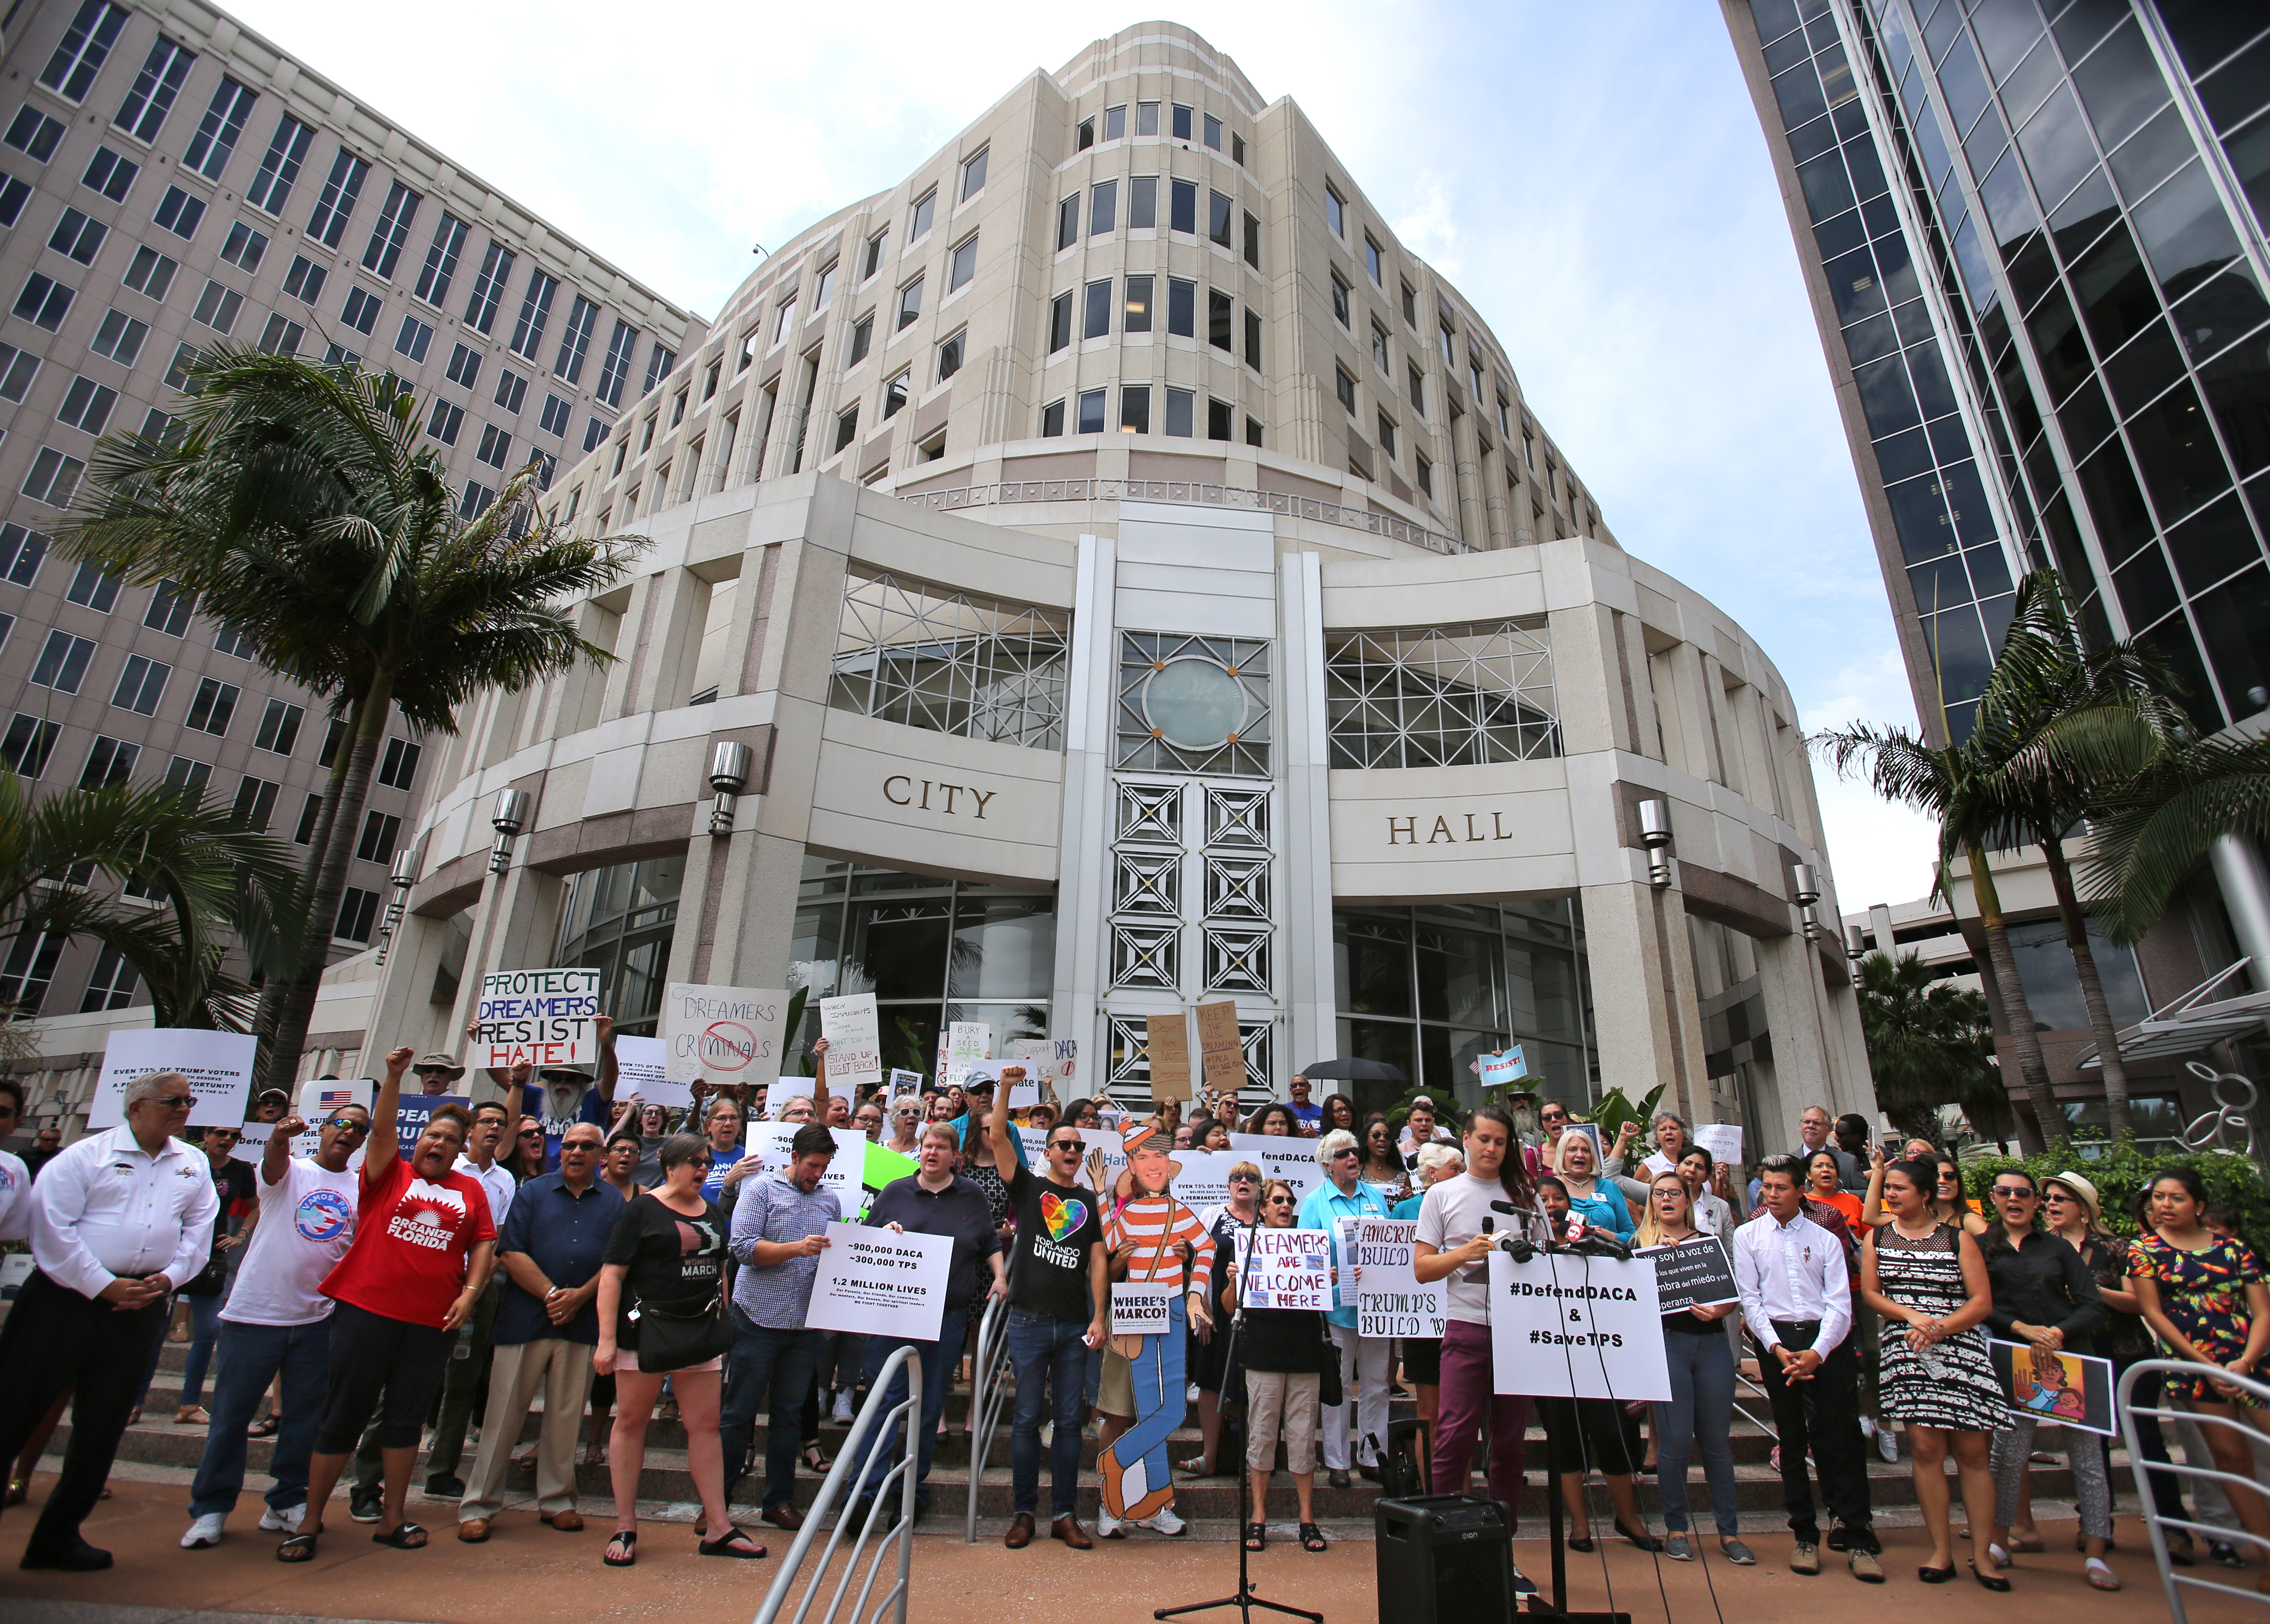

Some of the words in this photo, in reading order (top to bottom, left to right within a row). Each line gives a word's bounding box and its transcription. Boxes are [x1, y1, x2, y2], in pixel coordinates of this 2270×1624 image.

[883, 775, 998, 819] CITY
[1386, 812, 1512, 845] HALL
[482, 971, 599, 997] PROTECT
[479, 996, 598, 1020] DREAMERS
[685, 997, 776, 1021] DREAMERS
[830, 1008, 871, 1018] IMMIGRANTS
[1200, 1005, 1230, 1021] KEEP
[478, 1018, 589, 1045] RESIST
[958, 1026, 980, 1034] BURY
[1151, 1020, 1183, 1035] Deport
[676, 1034, 771, 1058] CRIMINALS
[829, 1038, 850, 1047] WHAT
[1015, 1040, 1051, 1057] Support
[1055, 1040, 1077, 1060] DACA
[1162, 1037, 1176, 1048] Hate
[1202, 1039, 1238, 1051] DREAMING
[828, 1053, 856, 1064] STAND
[852, 1056, 878, 1071] BACK!
[1161, 1051, 1181, 1061] NOT
[1206, 1055, 1229, 1064] #DACA
[1485, 1056, 1521, 1071] RESIST!
[1152, 1066, 1188, 1080] Dreamers
[1015, 1078, 1034, 1087] ate
[1103, 1153, 1127, 1165] Hat
[1262, 1152, 1315, 1163] fendDACA
[391, 1216, 455, 1241] ORGANIZE
[1360, 1224, 1417, 1244] AMERIC
[387, 1223, 448, 1251] FLORIDA
[1237, 1233, 1329, 1256] DREAMERS
[848, 1243, 892, 1254] ~900,000
[896, 1249, 923, 1258] DACA
[1036, 1234, 1080, 1257] #ORLANDO
[1659, 1253, 1675, 1262] soy
[1676, 1249, 1685, 1259] la
[1686, 1247, 1702, 1256] voz
[1703, 1243, 1714, 1253] de
[850, 1256, 894, 1267] ~300,000
[898, 1261, 917, 1270] TPS
[1033, 1243, 1078, 1269] UNITED
[1277, 1256, 1301, 1269] ARE
[1361, 1247, 1409, 1266] BUILD
[682, 1265, 717, 1276] MARCH
[832, 1277, 847, 1286] 1.2
[850, 1279, 894, 1292] MILLION
[897, 1285, 927, 1295] LIVES
[1241, 1274, 1326, 1292] WELCOME
[1657, 1281, 1681, 1293] mbra
[1681, 1280, 1691, 1288] del
[1691, 1274, 1715, 1286] miedo
[1510, 1282, 1637, 1301] #DefendDACA
[1113, 1296, 1166, 1307] WHERE'S
[1277, 1293, 1321, 1307] HERE
[1360, 1293, 1436, 1313] TRUMP'S
[1114, 1308, 1167, 1319] MARCO?
[1569, 1308, 1581, 1322] &
[1361, 1315, 1420, 1336] BUILD
[1529, 1330, 1623, 1347] #SaveTPS
[2043, 1412, 2079, 1423] DEPORTATIONS
